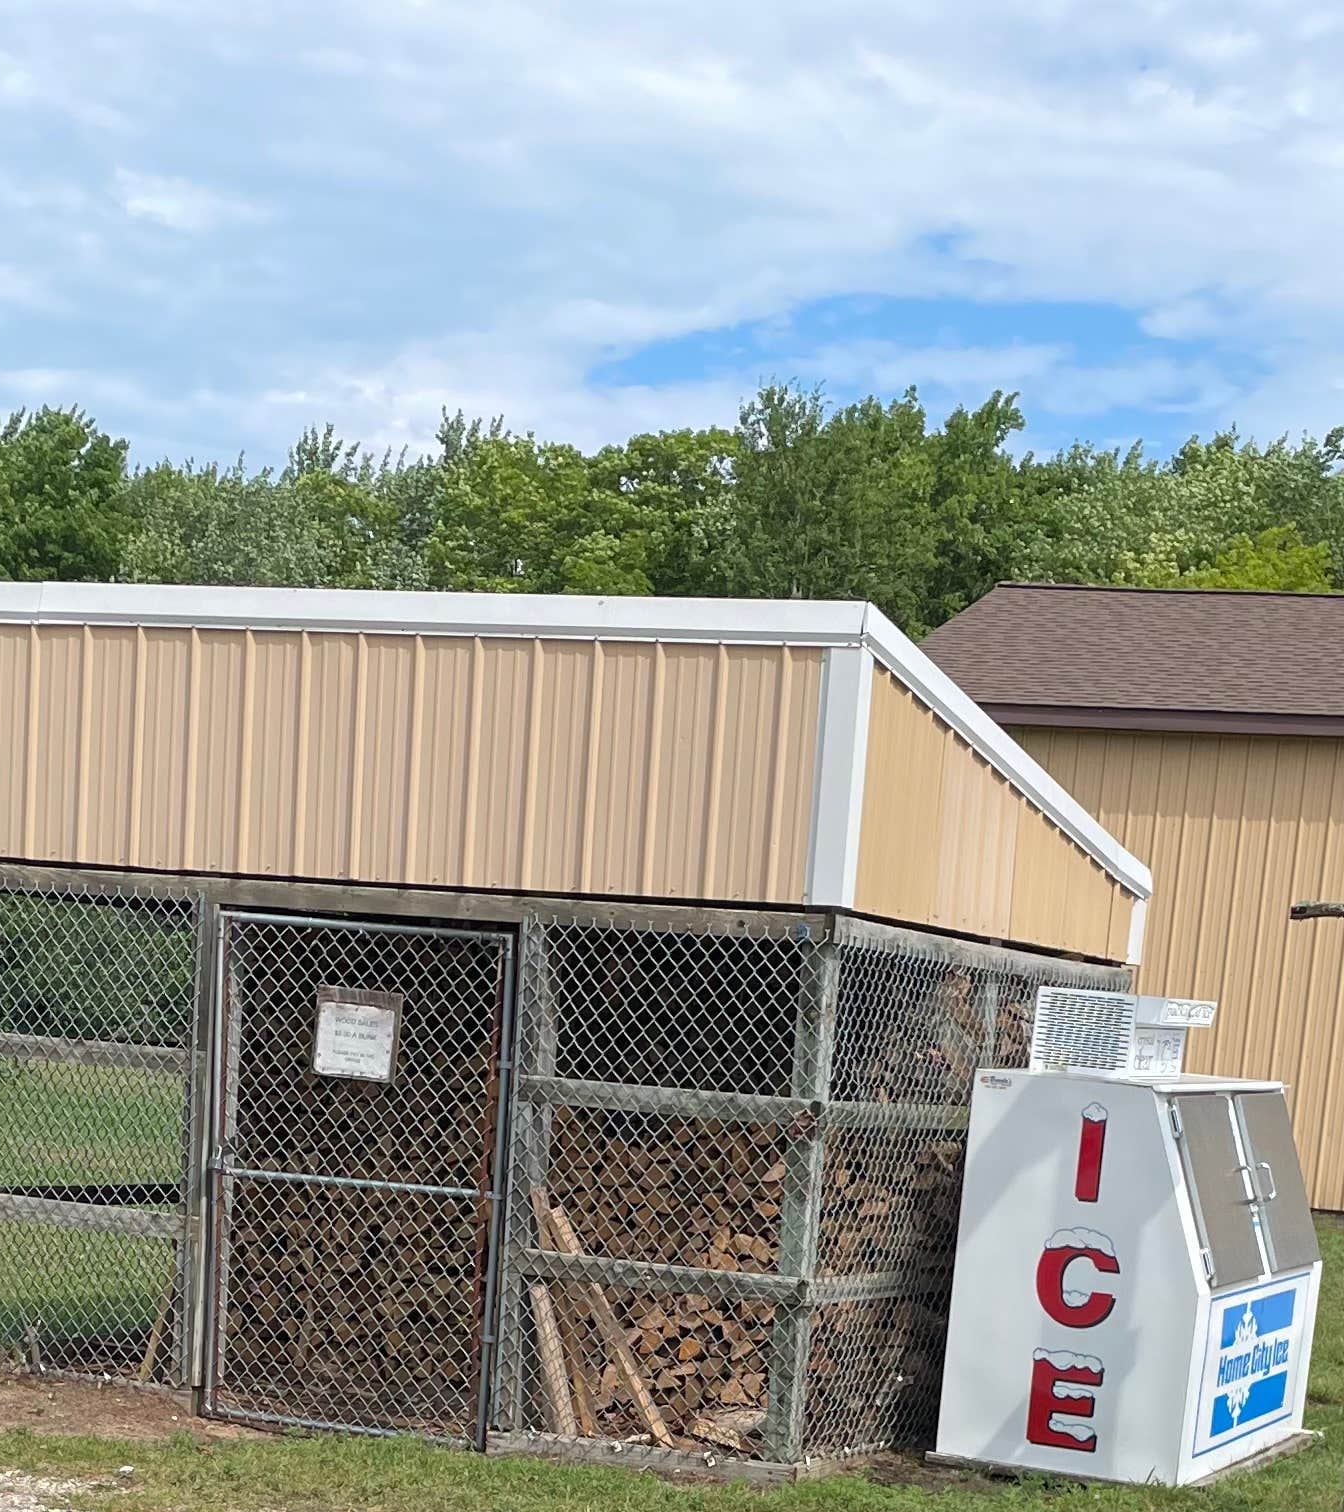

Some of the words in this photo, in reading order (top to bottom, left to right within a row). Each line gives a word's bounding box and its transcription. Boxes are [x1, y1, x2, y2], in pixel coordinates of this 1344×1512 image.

[1026, 1102, 1120, 1453] ICE
[1217, 1352, 1251, 1388] Home
[1251, 1341, 1273, 1377] City
[1271, 1338, 1289, 1367] Ice
